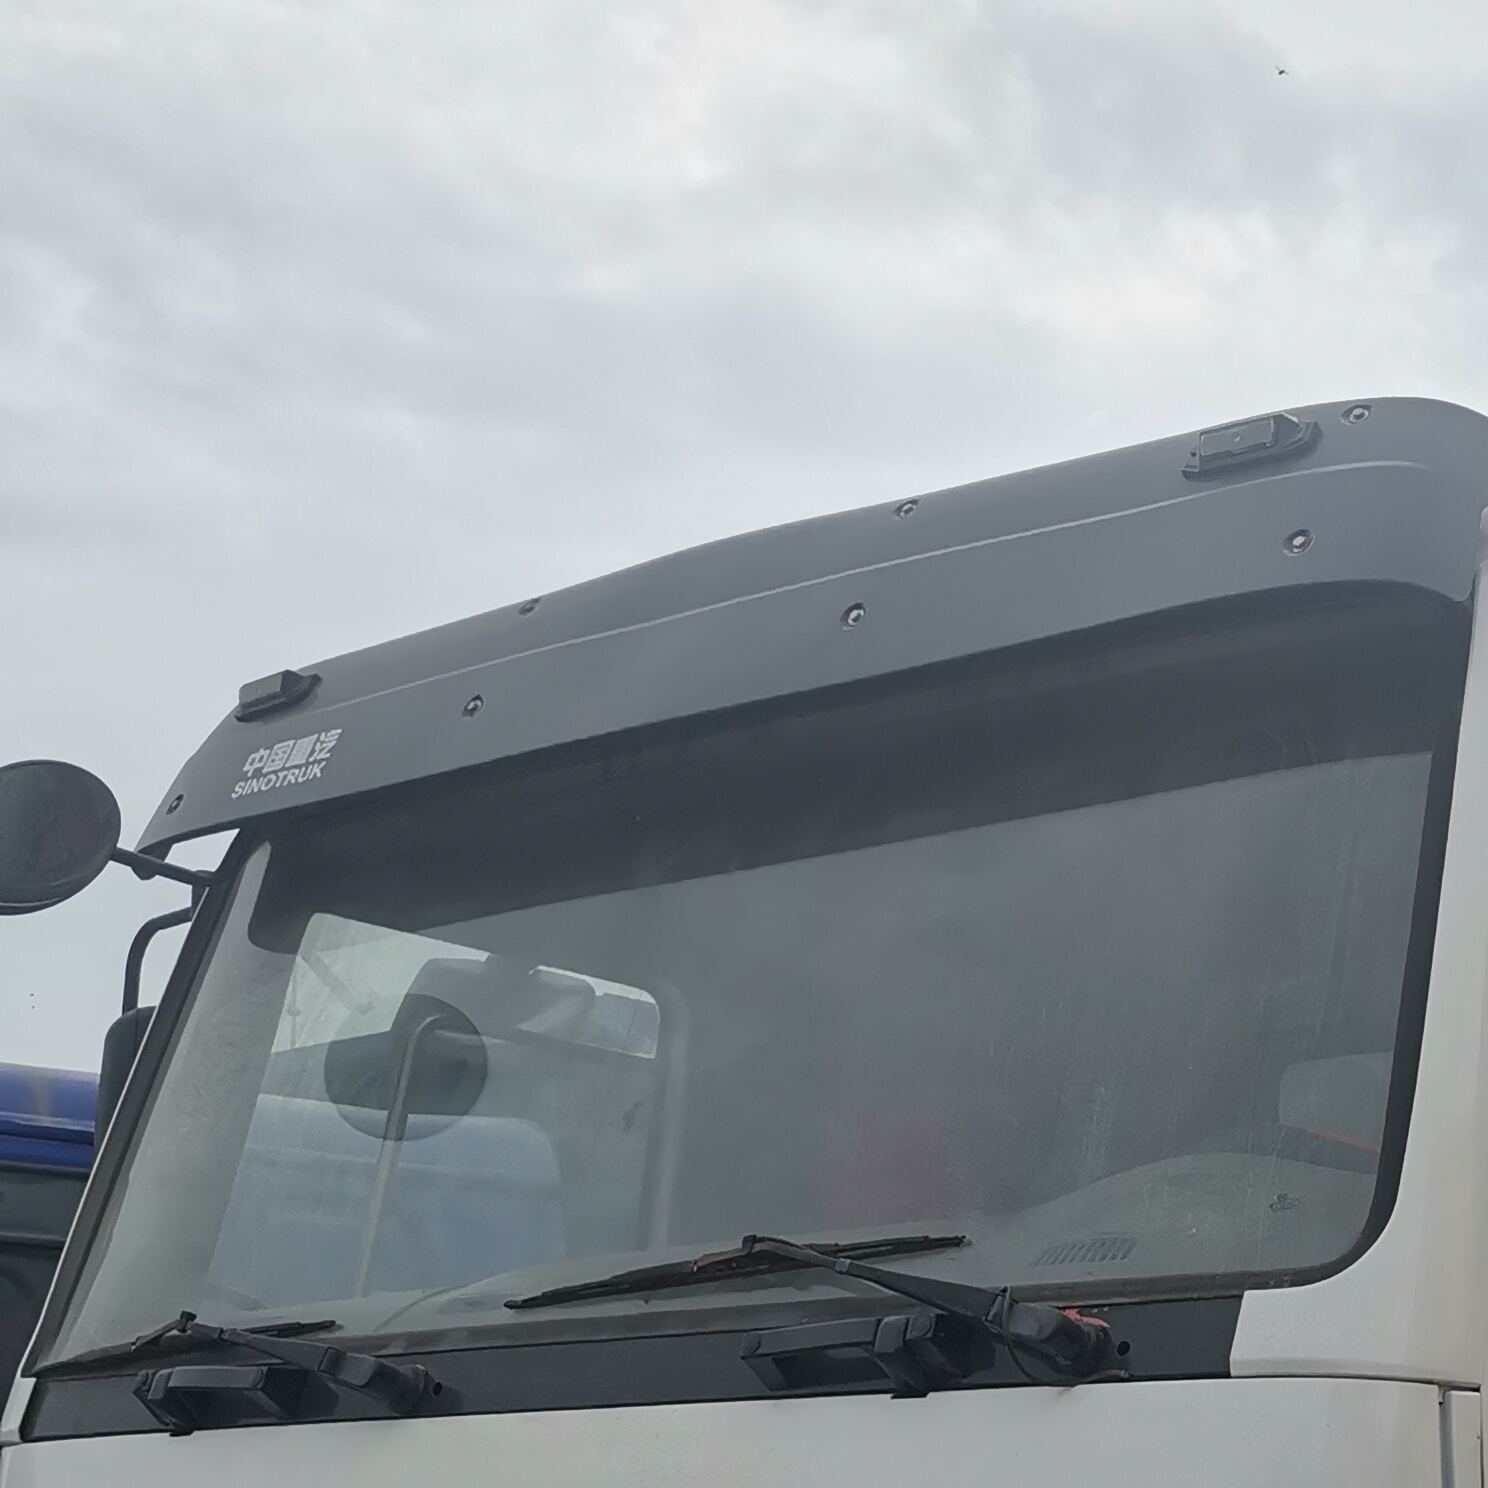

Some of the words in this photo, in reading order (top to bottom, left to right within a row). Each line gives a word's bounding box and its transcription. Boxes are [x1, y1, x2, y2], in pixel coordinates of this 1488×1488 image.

[243, 728, 342, 777] 中国汽
[231, 761, 327, 799] SINOTRUK
